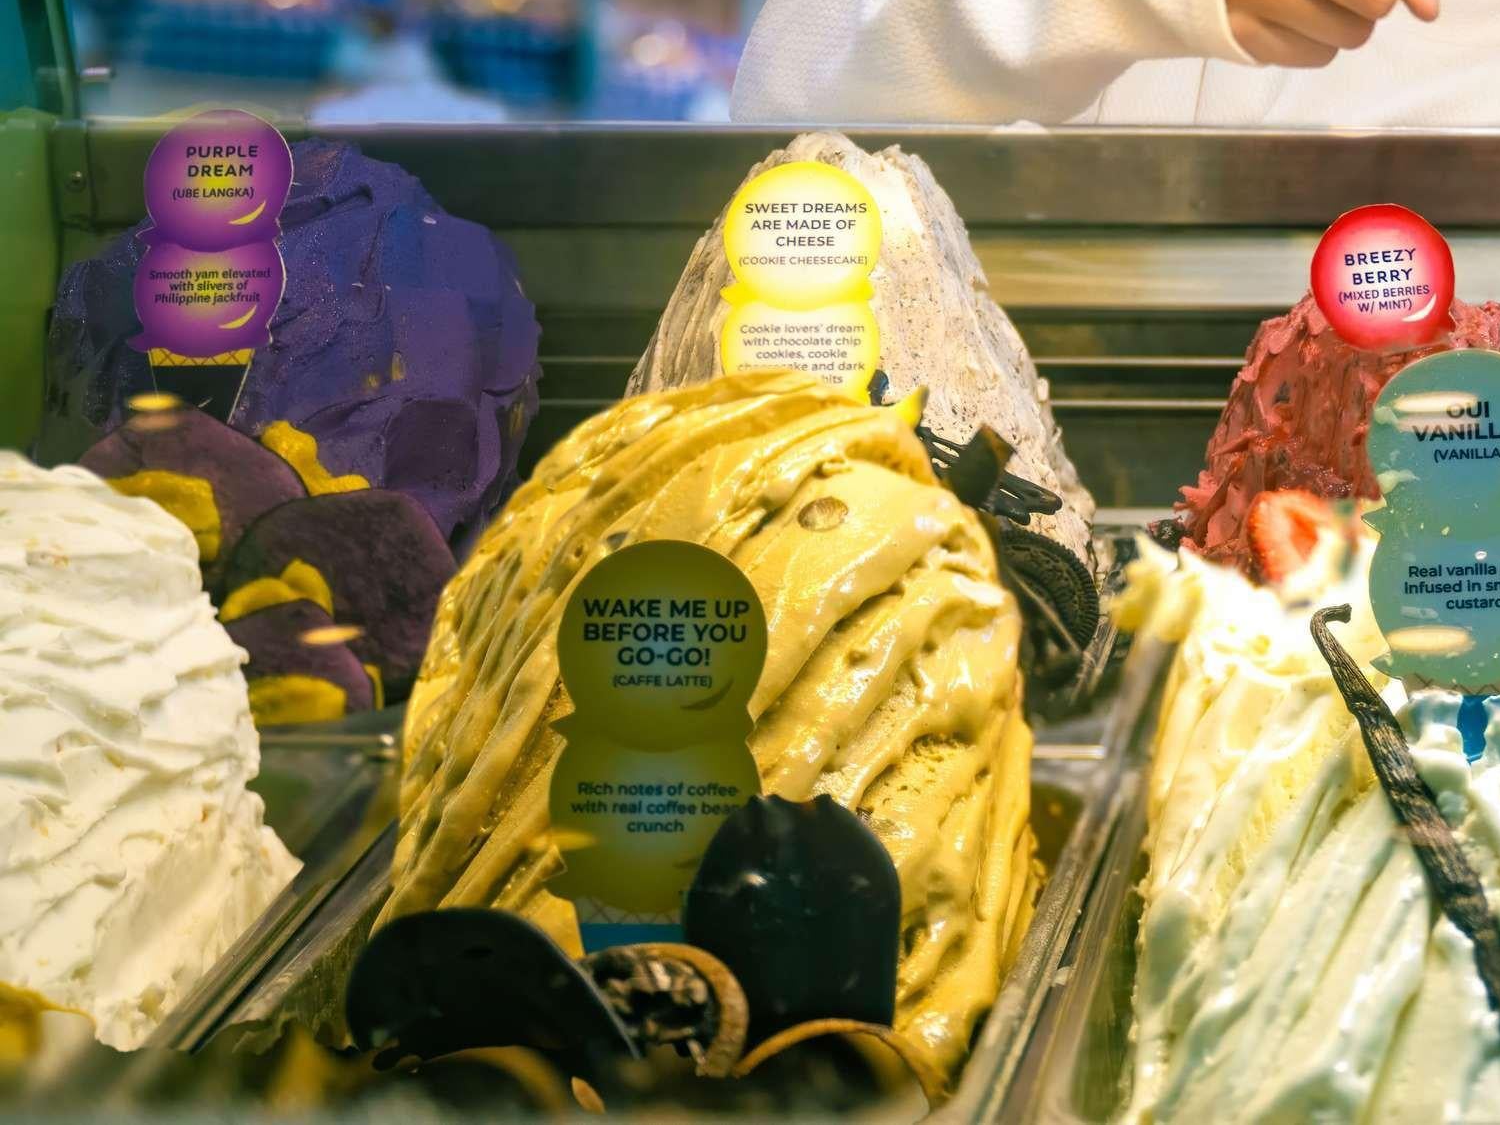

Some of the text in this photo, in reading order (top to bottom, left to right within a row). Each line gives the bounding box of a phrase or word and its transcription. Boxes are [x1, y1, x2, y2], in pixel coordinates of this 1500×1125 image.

[186, 145, 259, 158] PURPLE
[188, 165, 253, 177] DREAM
[173, 187, 254, 200] (UBE LANGKA)
[745, 203, 867, 214] SWEET DREAMS
[751, 219, 856, 230] ARE MADE OF
[776, 236, 835, 247] CHEESE
[738, 256, 868, 267] (COOKIE CHEESECAKE)
[1344, 248, 1416, 266] BREEZY
[149, 267, 271, 281] Smooth yam elevated
[1352, 268, 1413, 285] BERRY
[169, 280, 249, 291] with slivers of
[154, 292, 260, 305] Philippine jackfruit
[1339, 284, 1430, 304] (MIXED BERRIES
[1358, 298, 1412, 313] W/ MINT)
[740, 324, 781, 334] Cookie
[826, 324, 865, 334] dream
[743, 337, 861, 347] with chocolate chip
[756, 349, 848, 360] cookies, cookie
[811, 362, 835, 371] and
[837, 362, 865, 371] dark
[1446, 401, 1490, 418] OUI
[1409, 565, 1442, 578] Real
[1446, 564, 1497, 576] vanilla
[1404, 581, 1462, 595] infused
[1467, 579, 1482, 592] in
[583, 599, 750, 619] WAKE ME UP
[583, 623, 747, 643] BEFORE YOU
[617, 646, 710, 666] GO-GO!
[666, 674, 713, 689] LATTE)
[577, 782, 738, 797] Rich notes of coffee
[571, 801, 608, 814] with
[612, 801, 642, 814] real
[646, 801, 697, 815] coffee
[626, 819, 684, 833] crunch
